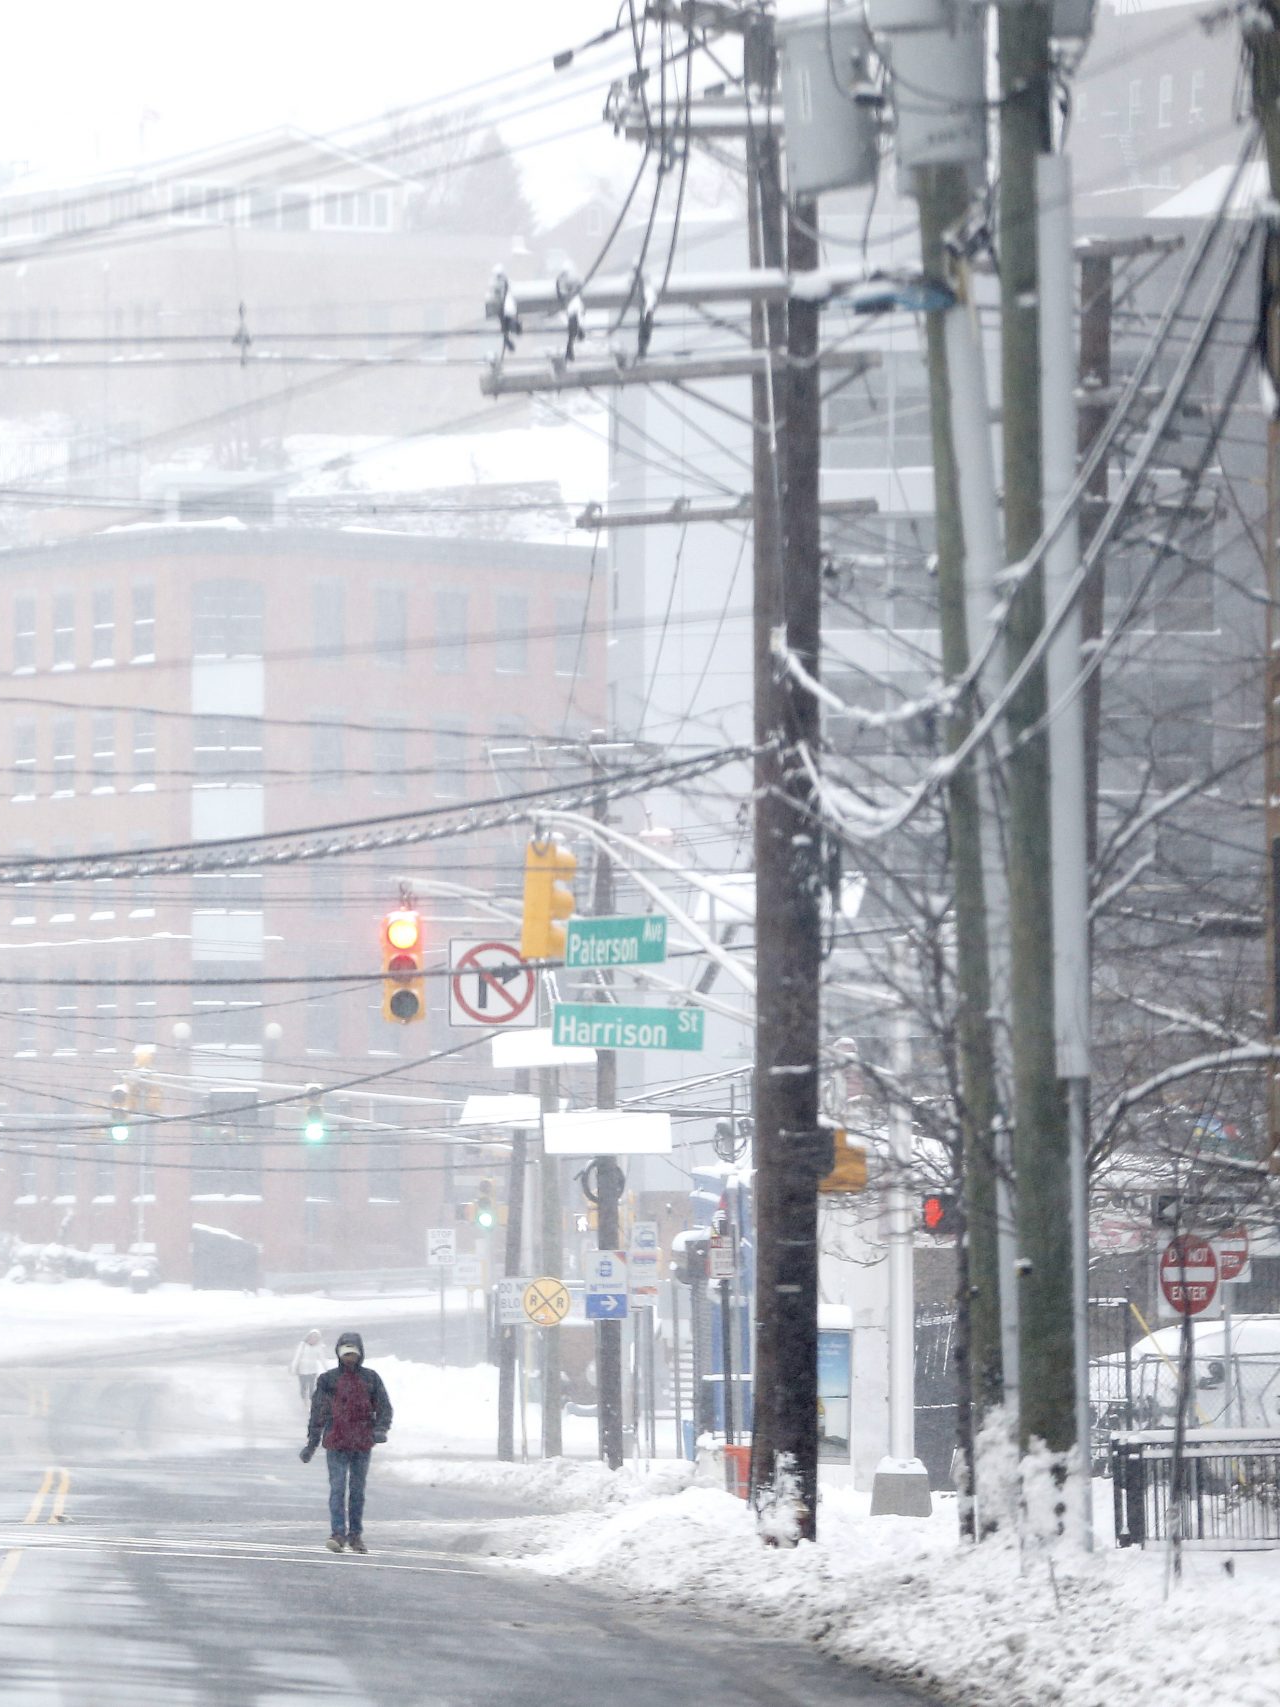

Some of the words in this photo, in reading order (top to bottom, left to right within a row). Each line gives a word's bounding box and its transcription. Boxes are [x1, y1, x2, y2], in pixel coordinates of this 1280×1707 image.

[568, 933, 639, 965] Paterson
[642, 919, 664, 943] Ave
[559, 1015, 667, 1047] Harrison
[677, 1011, 699, 1033] St
[500, 1297, 521, 1309] BLO
[529, 1294, 538, 1306] R
[556, 1297, 565, 1308] R
